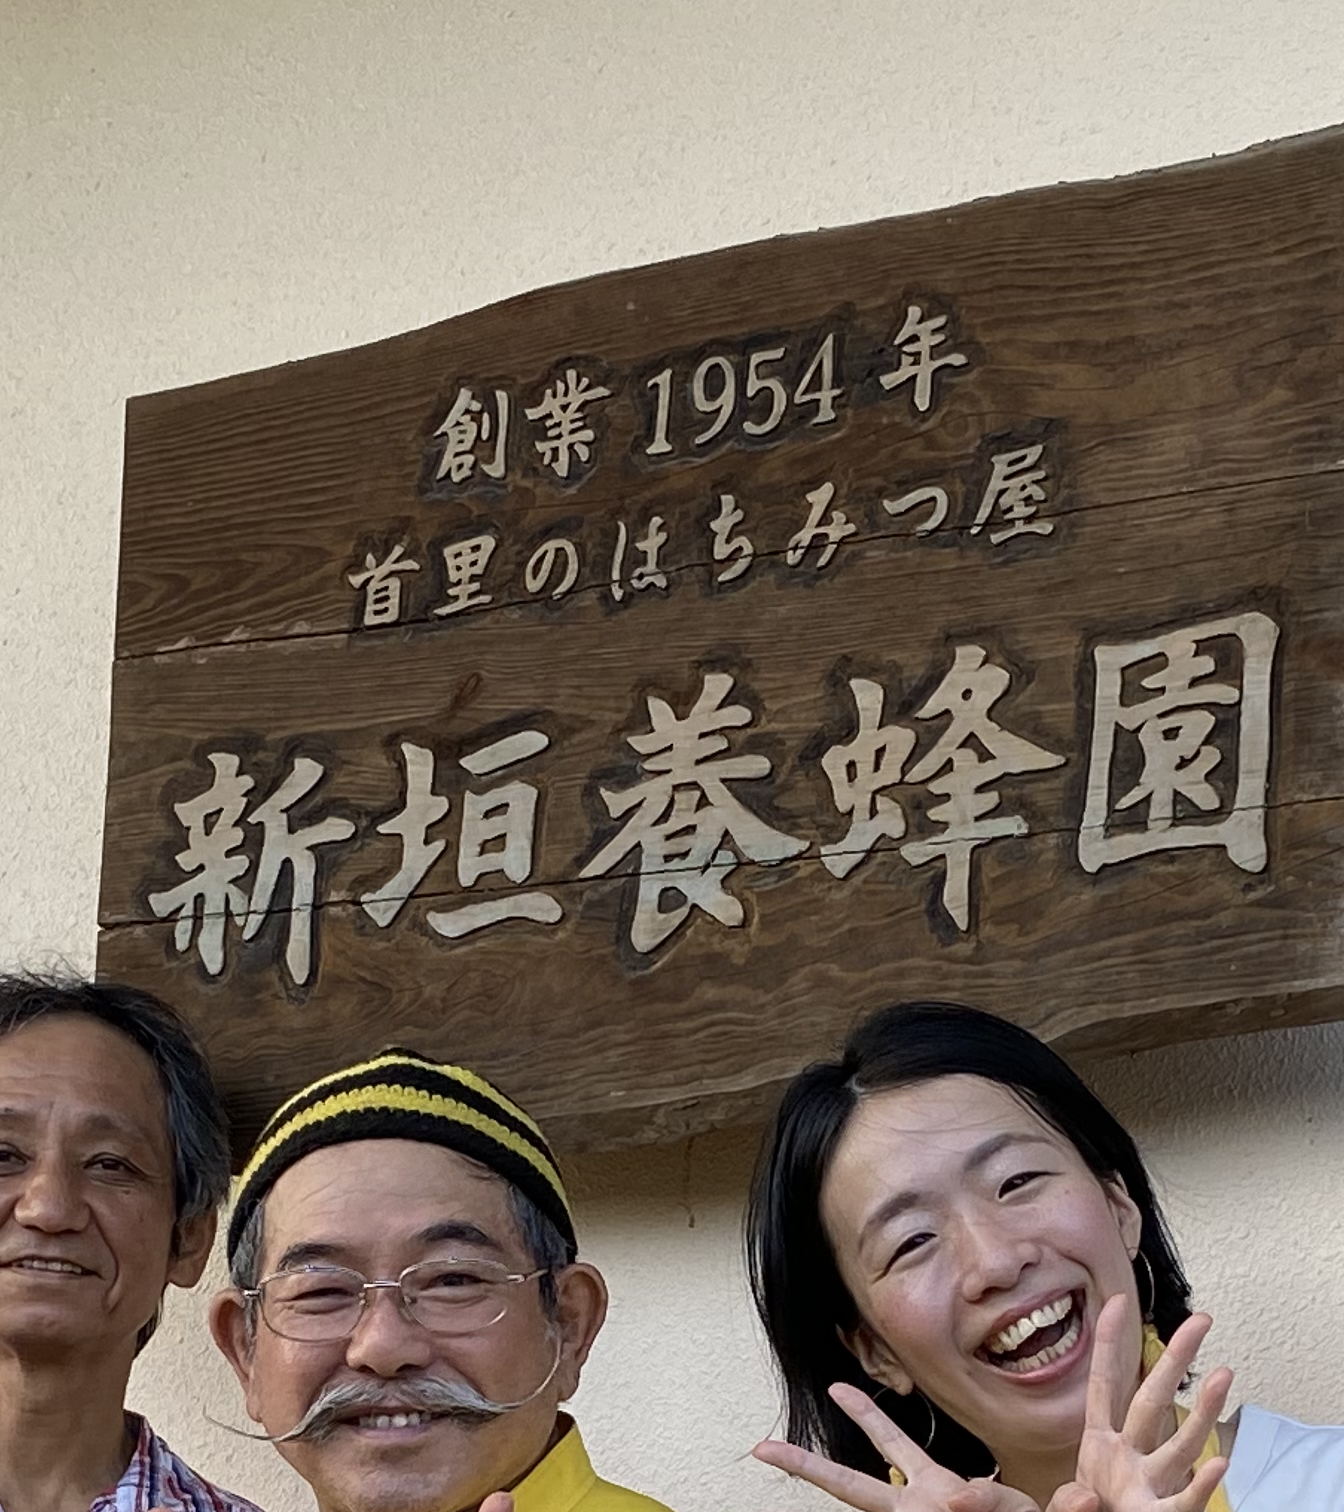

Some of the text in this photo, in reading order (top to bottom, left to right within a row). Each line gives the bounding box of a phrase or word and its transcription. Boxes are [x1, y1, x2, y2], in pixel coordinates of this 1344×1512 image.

[348, 444, 1054, 628] 首里のはちみつ屋
[148, 610, 1280, 987] 新垣養蜂園
